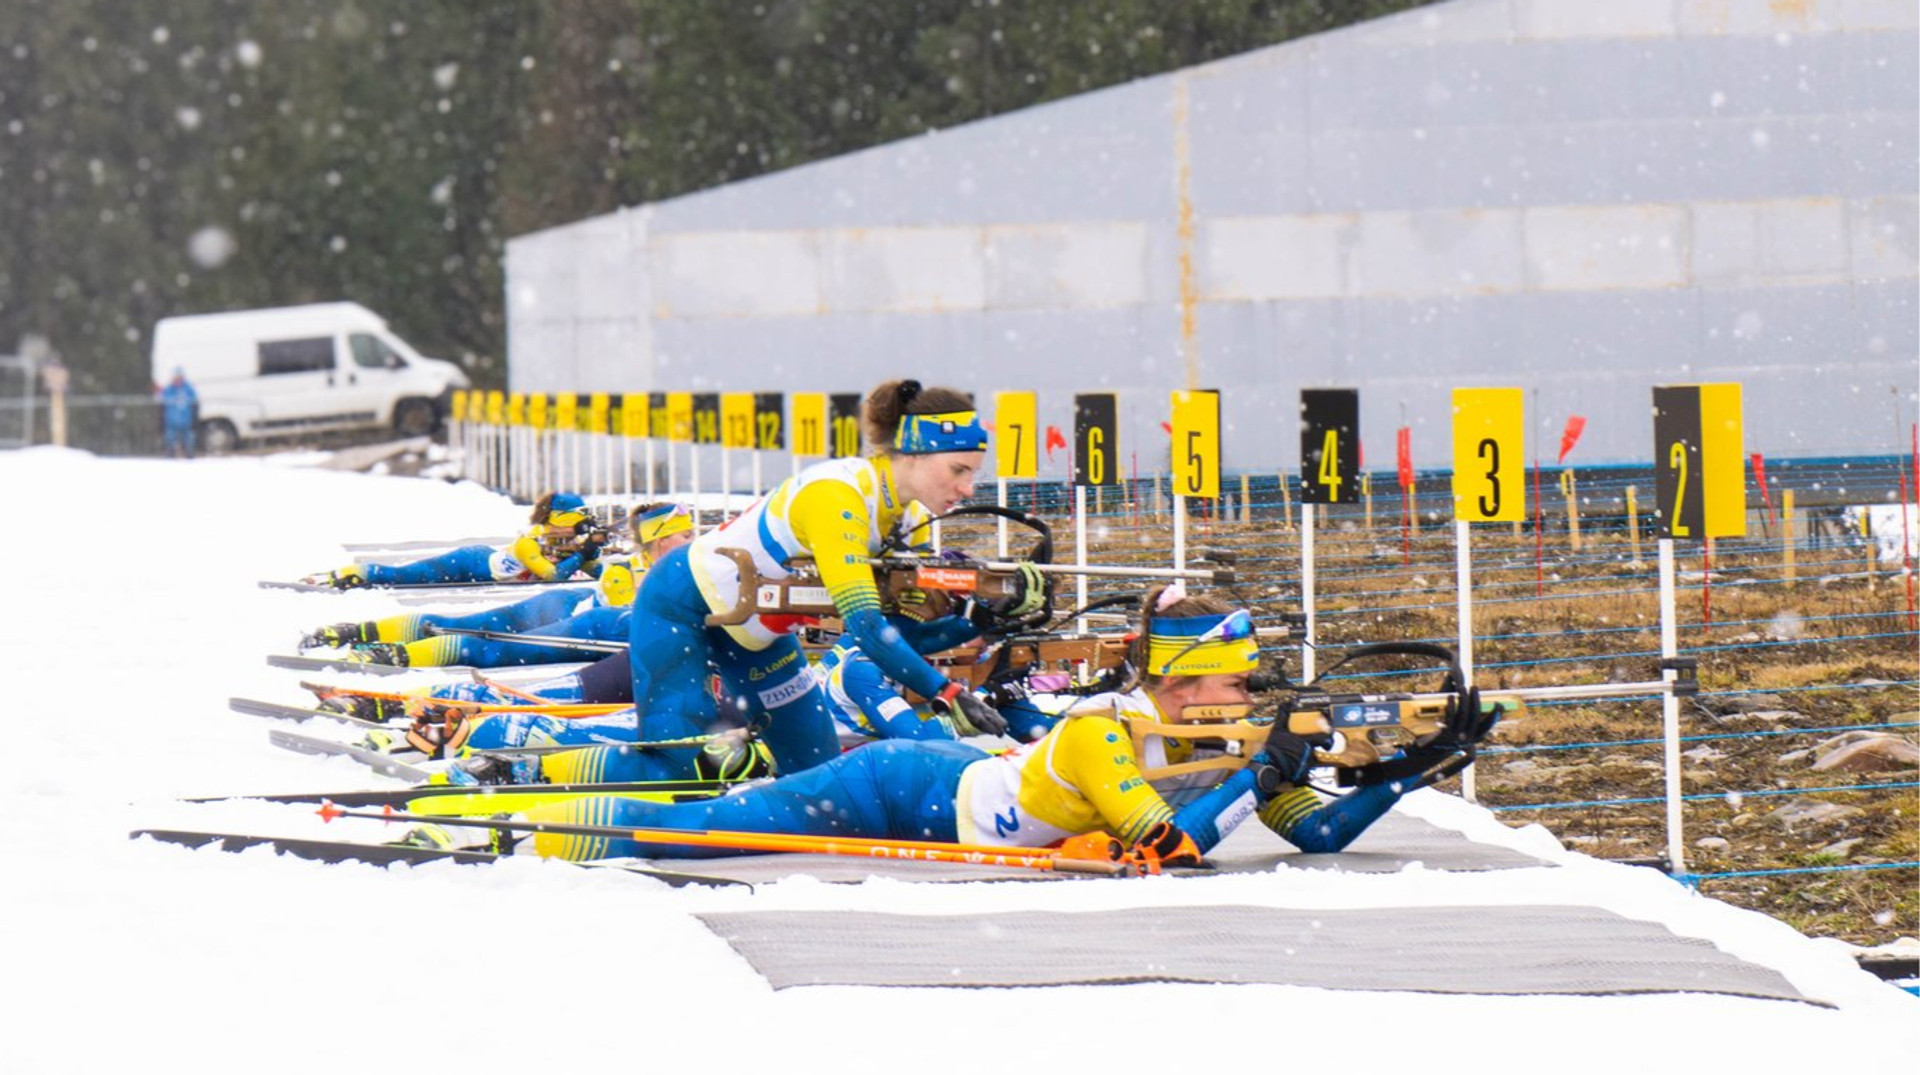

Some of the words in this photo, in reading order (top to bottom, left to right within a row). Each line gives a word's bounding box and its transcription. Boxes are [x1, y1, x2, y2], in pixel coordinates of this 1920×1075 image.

[729, 414, 748, 447] 13
[757, 412, 780, 449] 12
[801, 418, 816, 455] 11
[834, 416, 858, 457] 10
[1008, 424, 1022, 475] 7
[1087, 427, 1104, 484] 6
[1187, 430, 1203, 493] 5
[1317, 429, 1342, 502] 4
[1477, 438, 1501, 517] 3
[1669, 442, 1690, 536] 2
[994, 806, 1020, 839] 2
[870, 846, 943, 860] ONE
